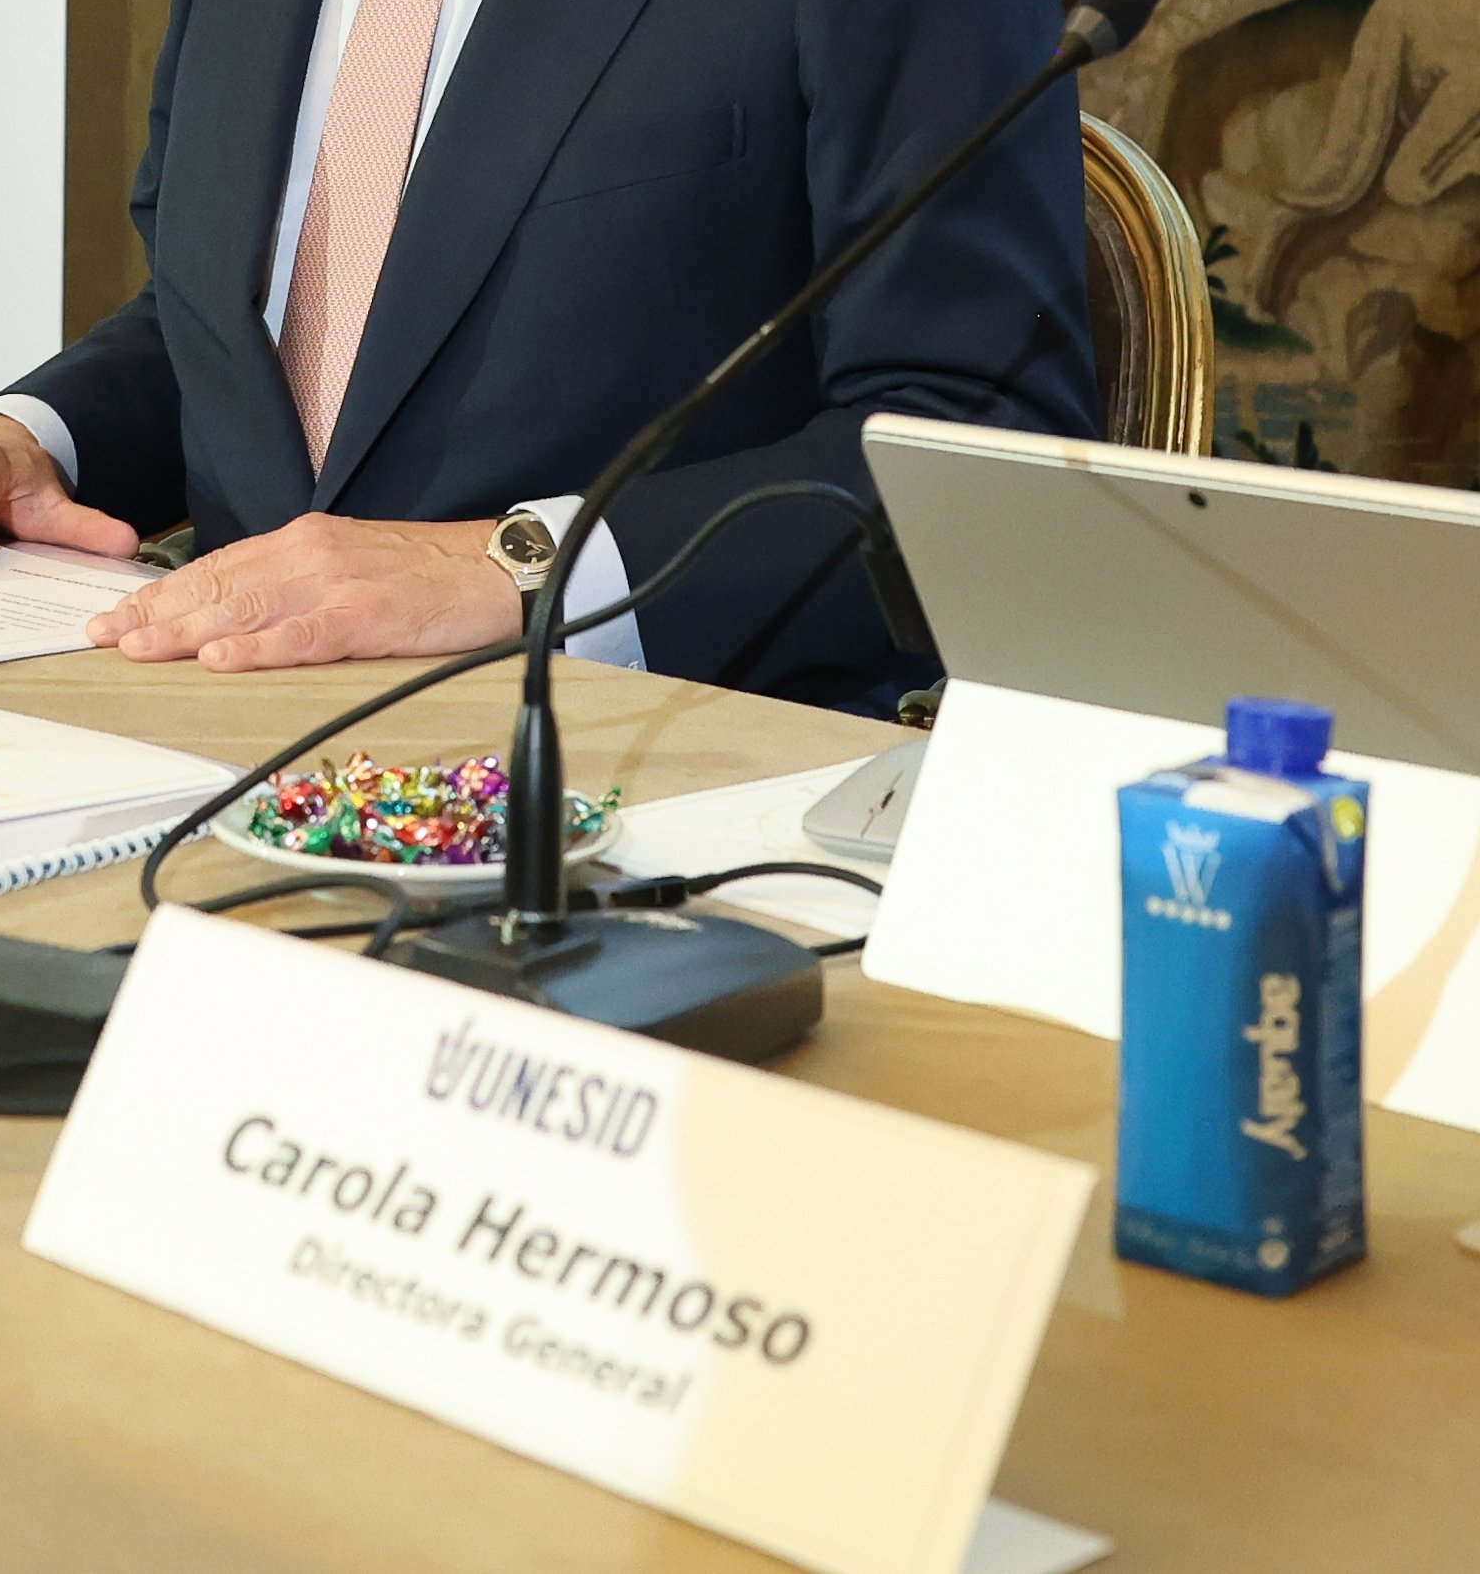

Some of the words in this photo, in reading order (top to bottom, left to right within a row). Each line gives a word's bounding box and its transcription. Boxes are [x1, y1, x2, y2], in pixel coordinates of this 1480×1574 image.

[467, 1042, 660, 1160] UNESID
[1239, 972, 1309, 1162] aqualy
[223, 1116, 439, 1234] Carola
[456, 1195, 812, 1366] Hermoso
[289, 1236, 491, 1341] Directora
[501, 1313, 695, 1414] General
